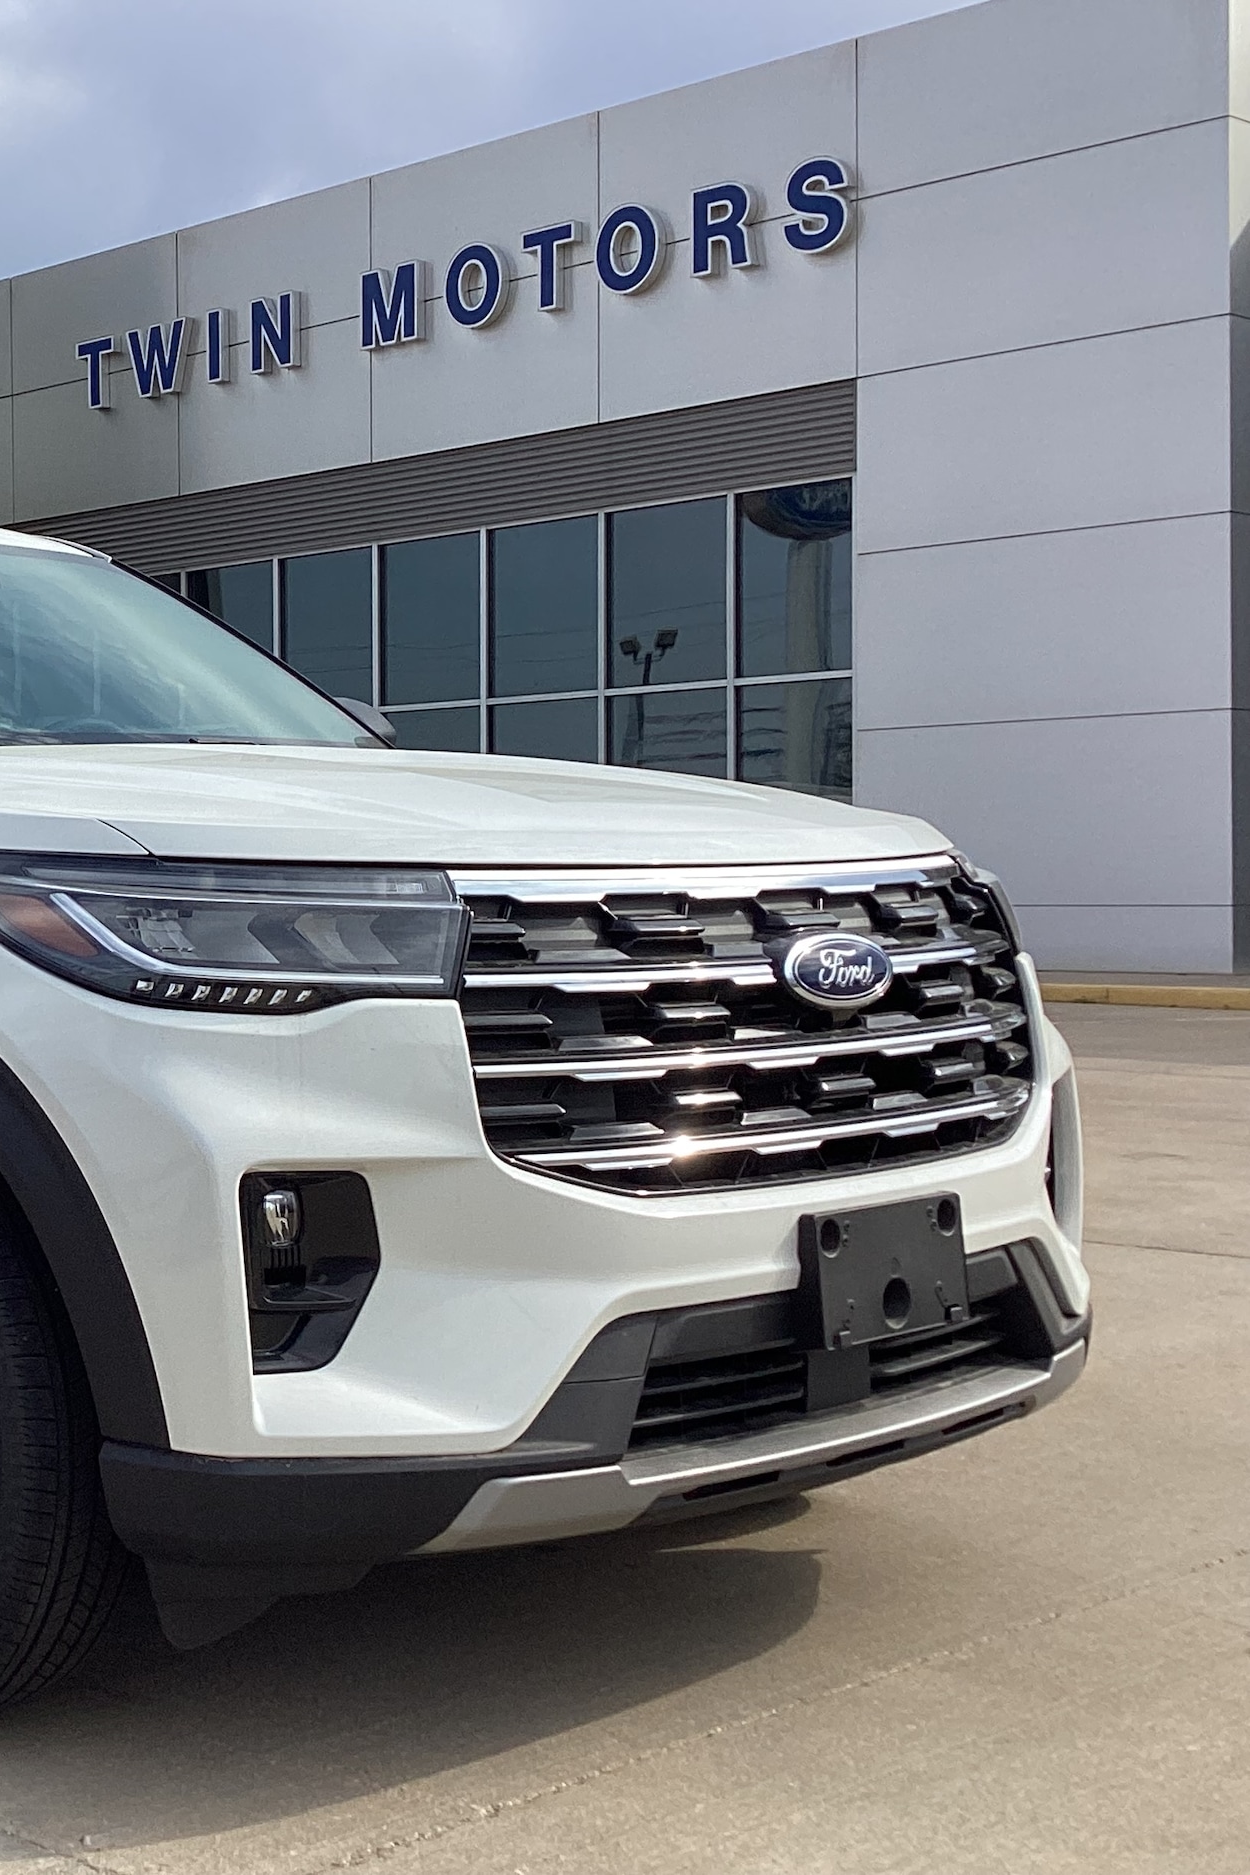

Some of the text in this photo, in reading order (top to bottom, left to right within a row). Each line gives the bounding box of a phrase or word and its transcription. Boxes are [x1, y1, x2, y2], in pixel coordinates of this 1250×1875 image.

[75, 155, 853, 409] TWIN MOTORS
[818, 948, 875, 989] Ford
